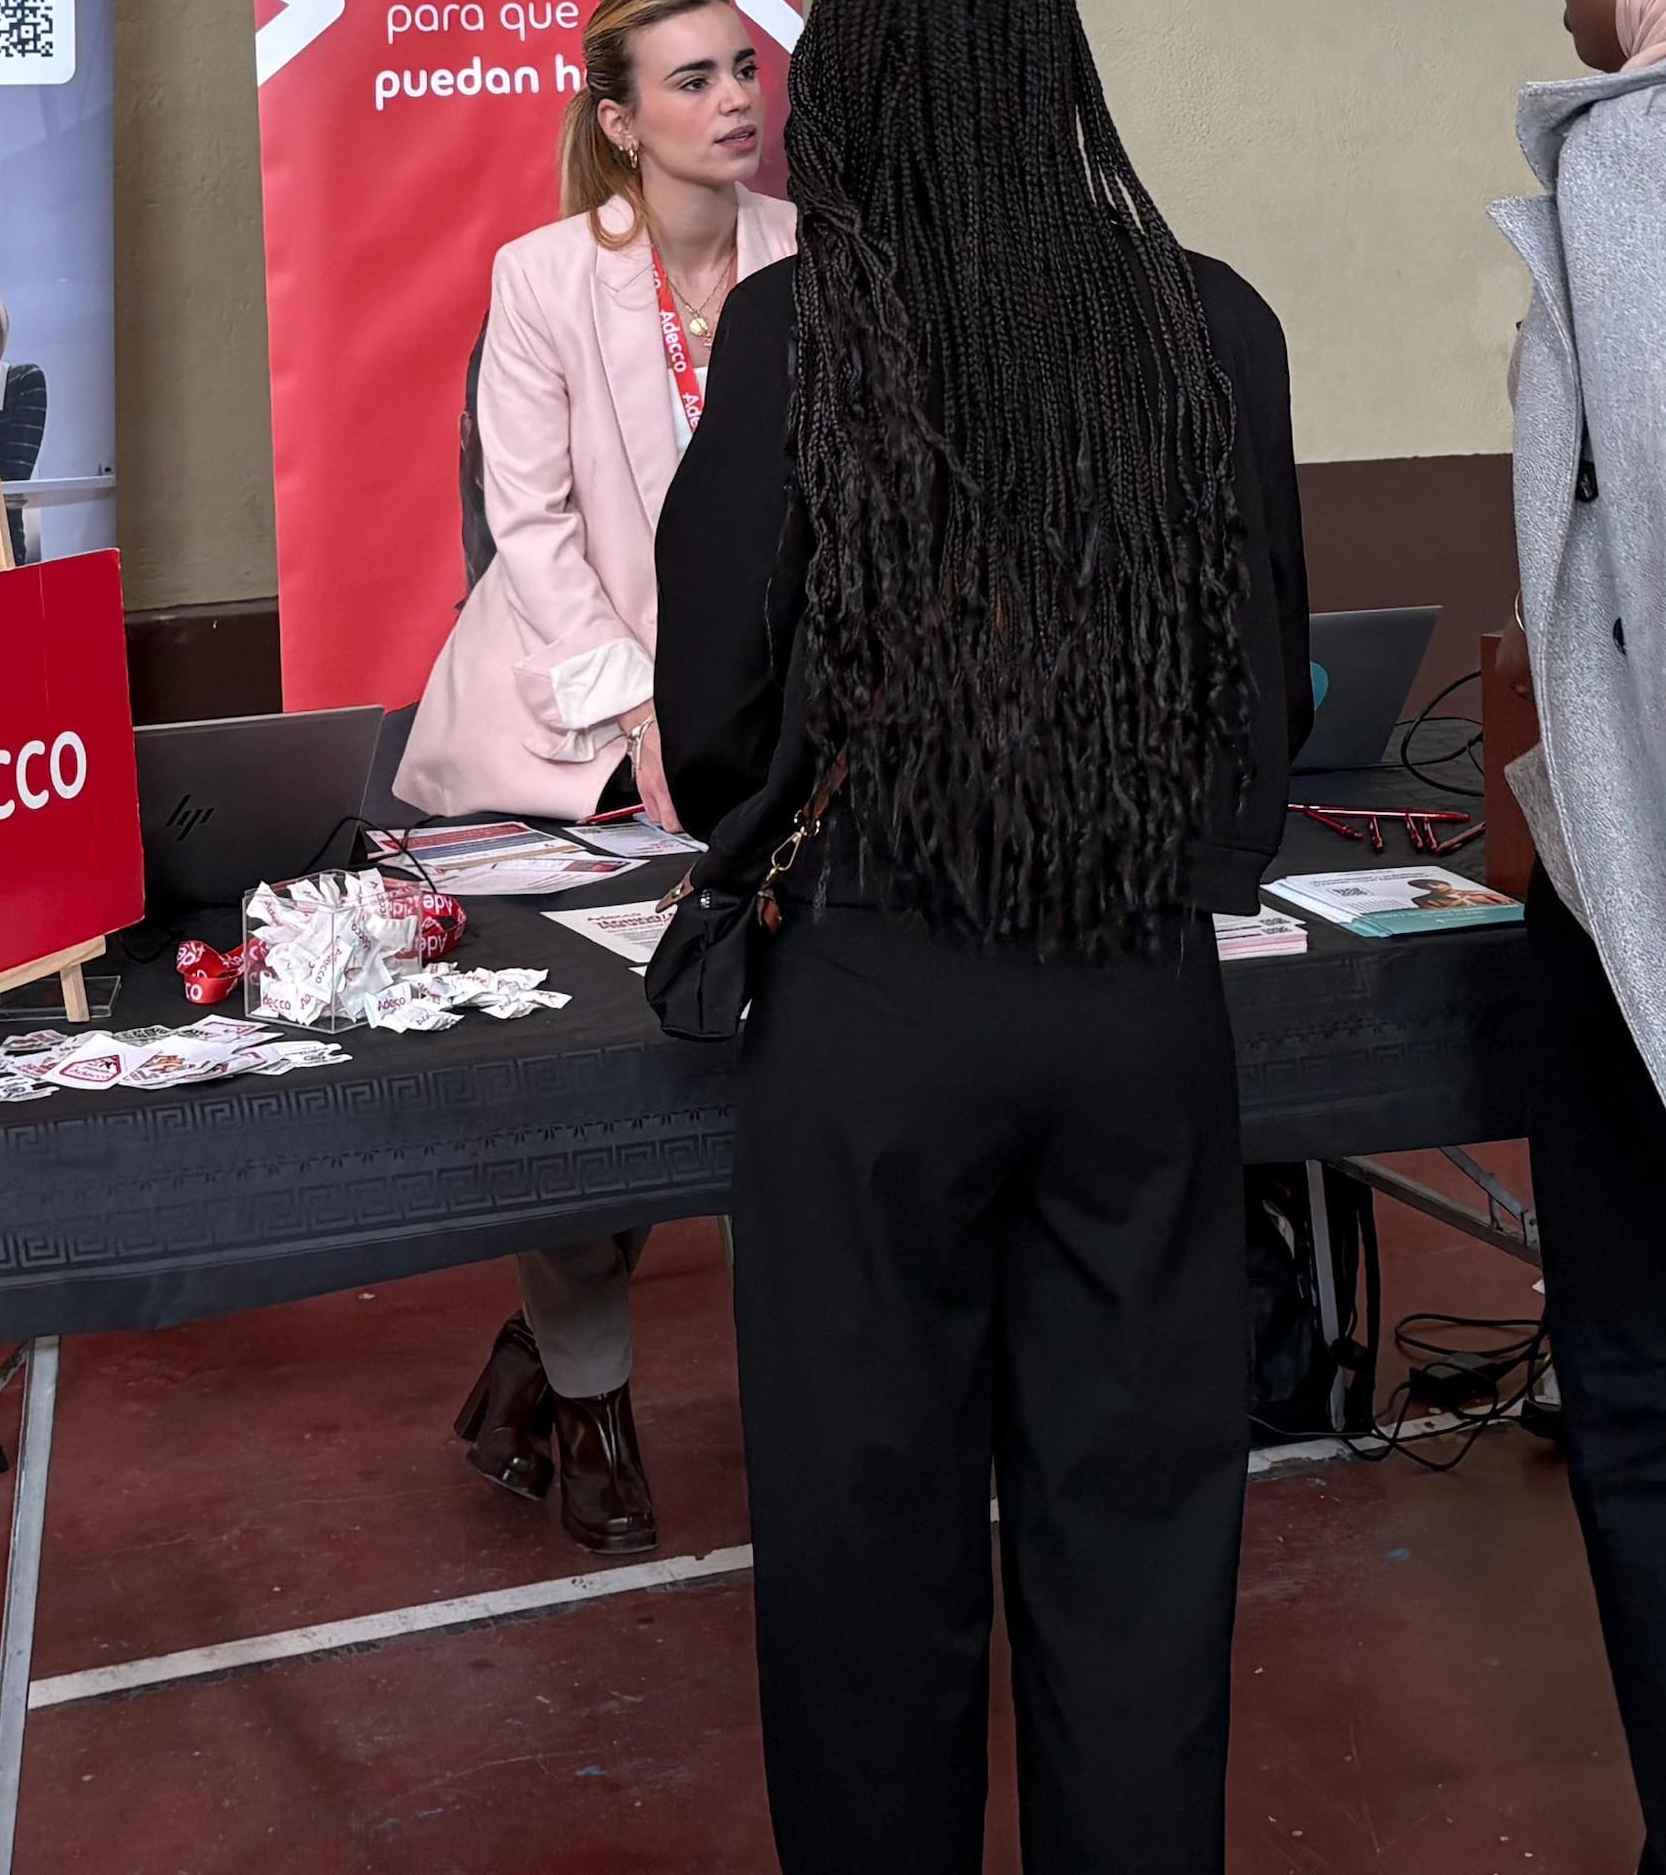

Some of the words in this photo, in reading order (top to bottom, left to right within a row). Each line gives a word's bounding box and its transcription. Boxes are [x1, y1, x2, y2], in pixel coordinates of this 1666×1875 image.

[386, 3, 485, 45] para
[499, 1, 580, 42] que
[374, 55, 540, 112] puedan
[659, 308, 688, 374] Adecco
